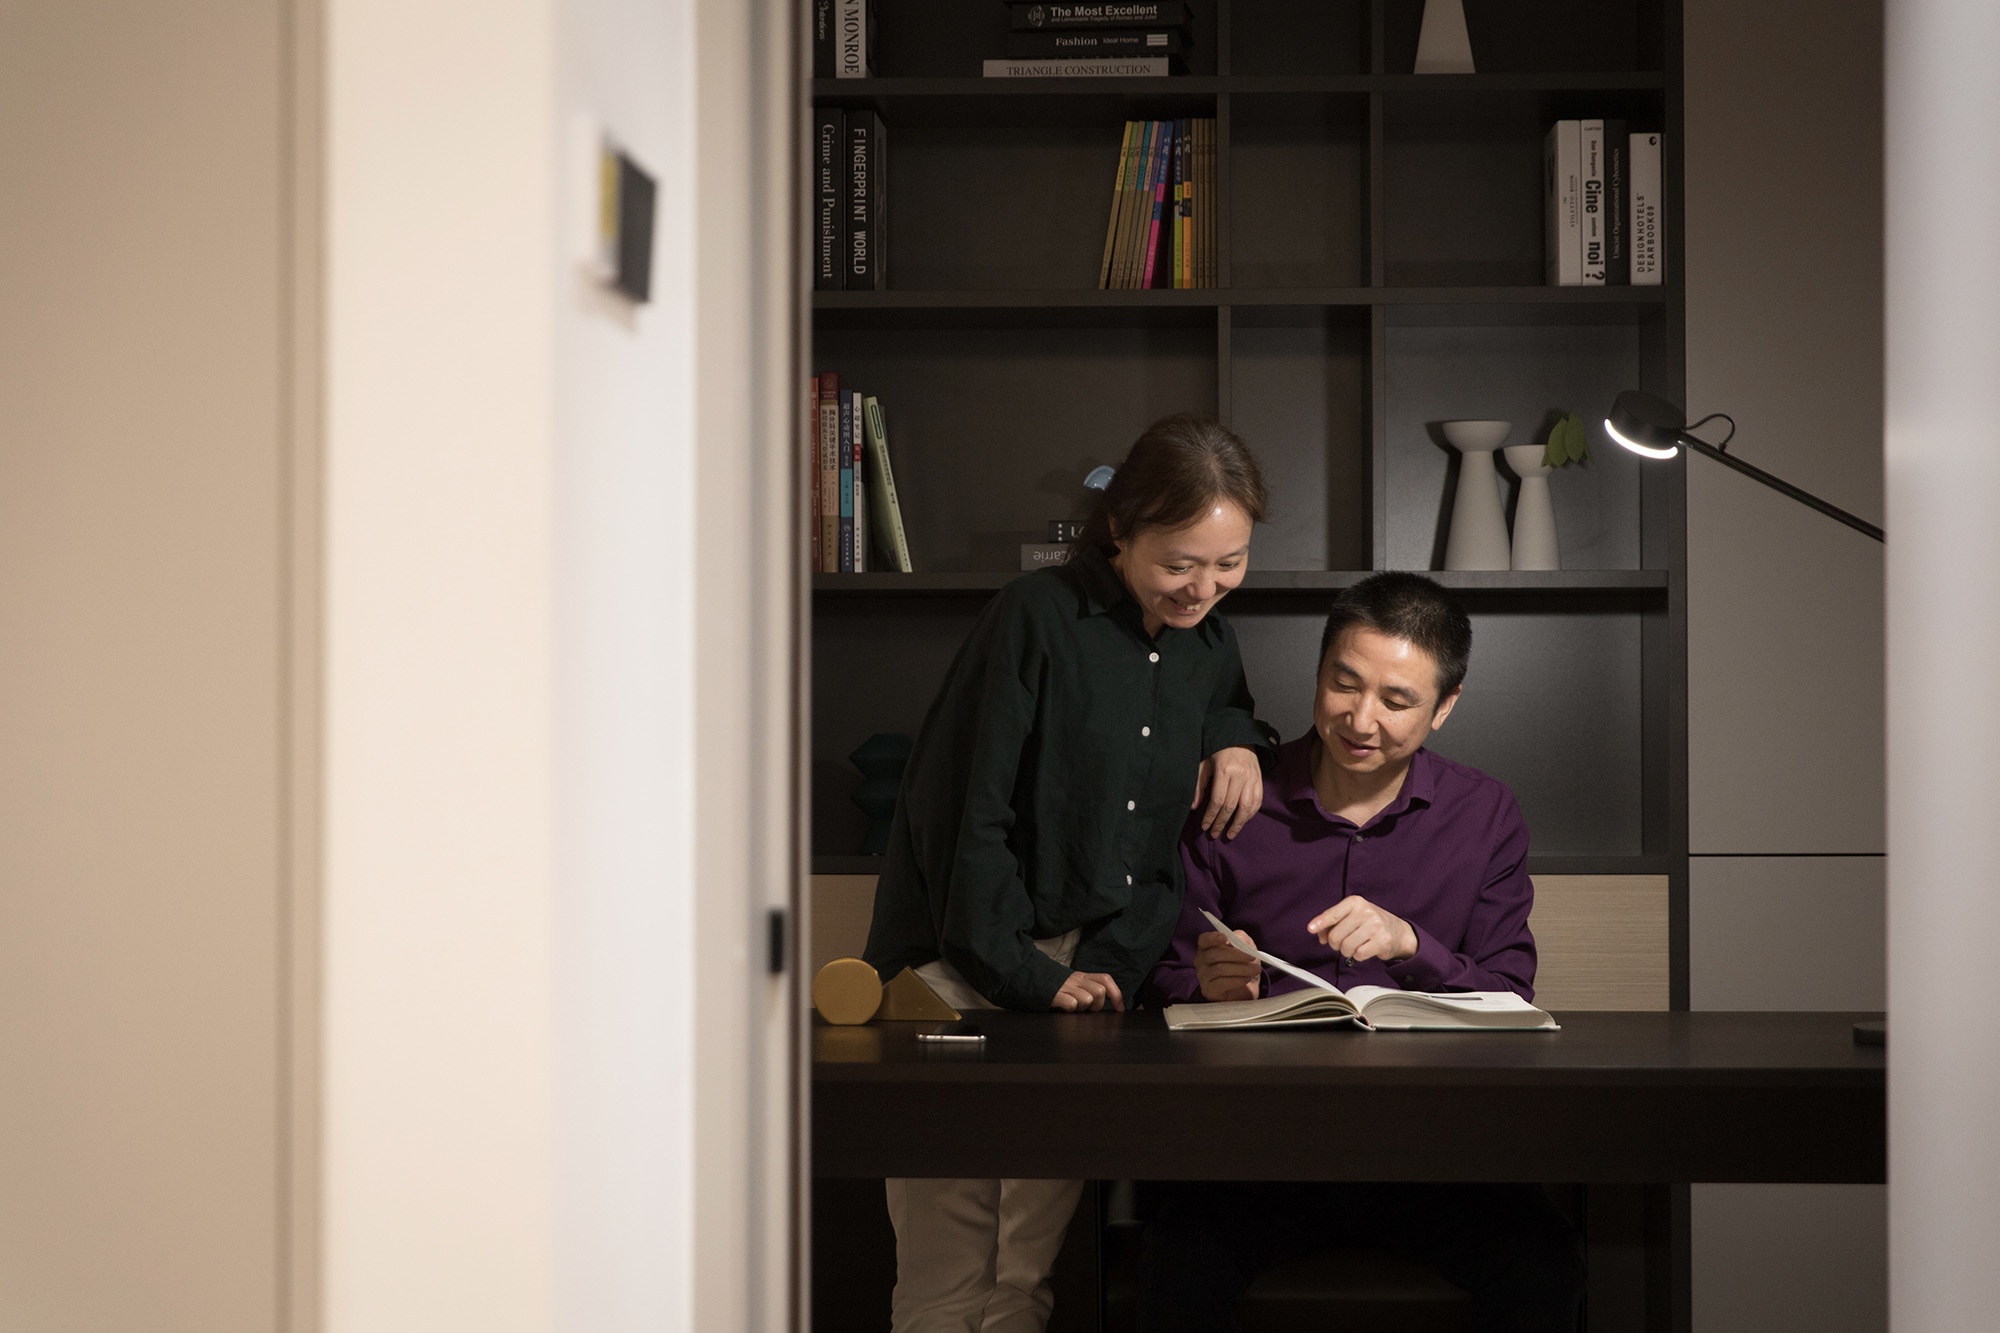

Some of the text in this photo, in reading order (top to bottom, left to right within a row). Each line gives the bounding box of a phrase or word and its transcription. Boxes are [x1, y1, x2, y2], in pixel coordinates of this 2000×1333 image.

[1051, 5, 1157, 16] The Most Excellent
[844, 9, 859, 73] MONROE
[1056, 37, 1098, 46] Fashion
[1007, 64, 1151, 76] TRIANGLE CONSTRUCTION
[822, 124, 835, 278] Crime and Punishment
[854, 128, 866, 274] FINGERPRINT WORLD
[1586, 180, 1601, 214] Cine
[1588, 242, 1603, 265] noi
